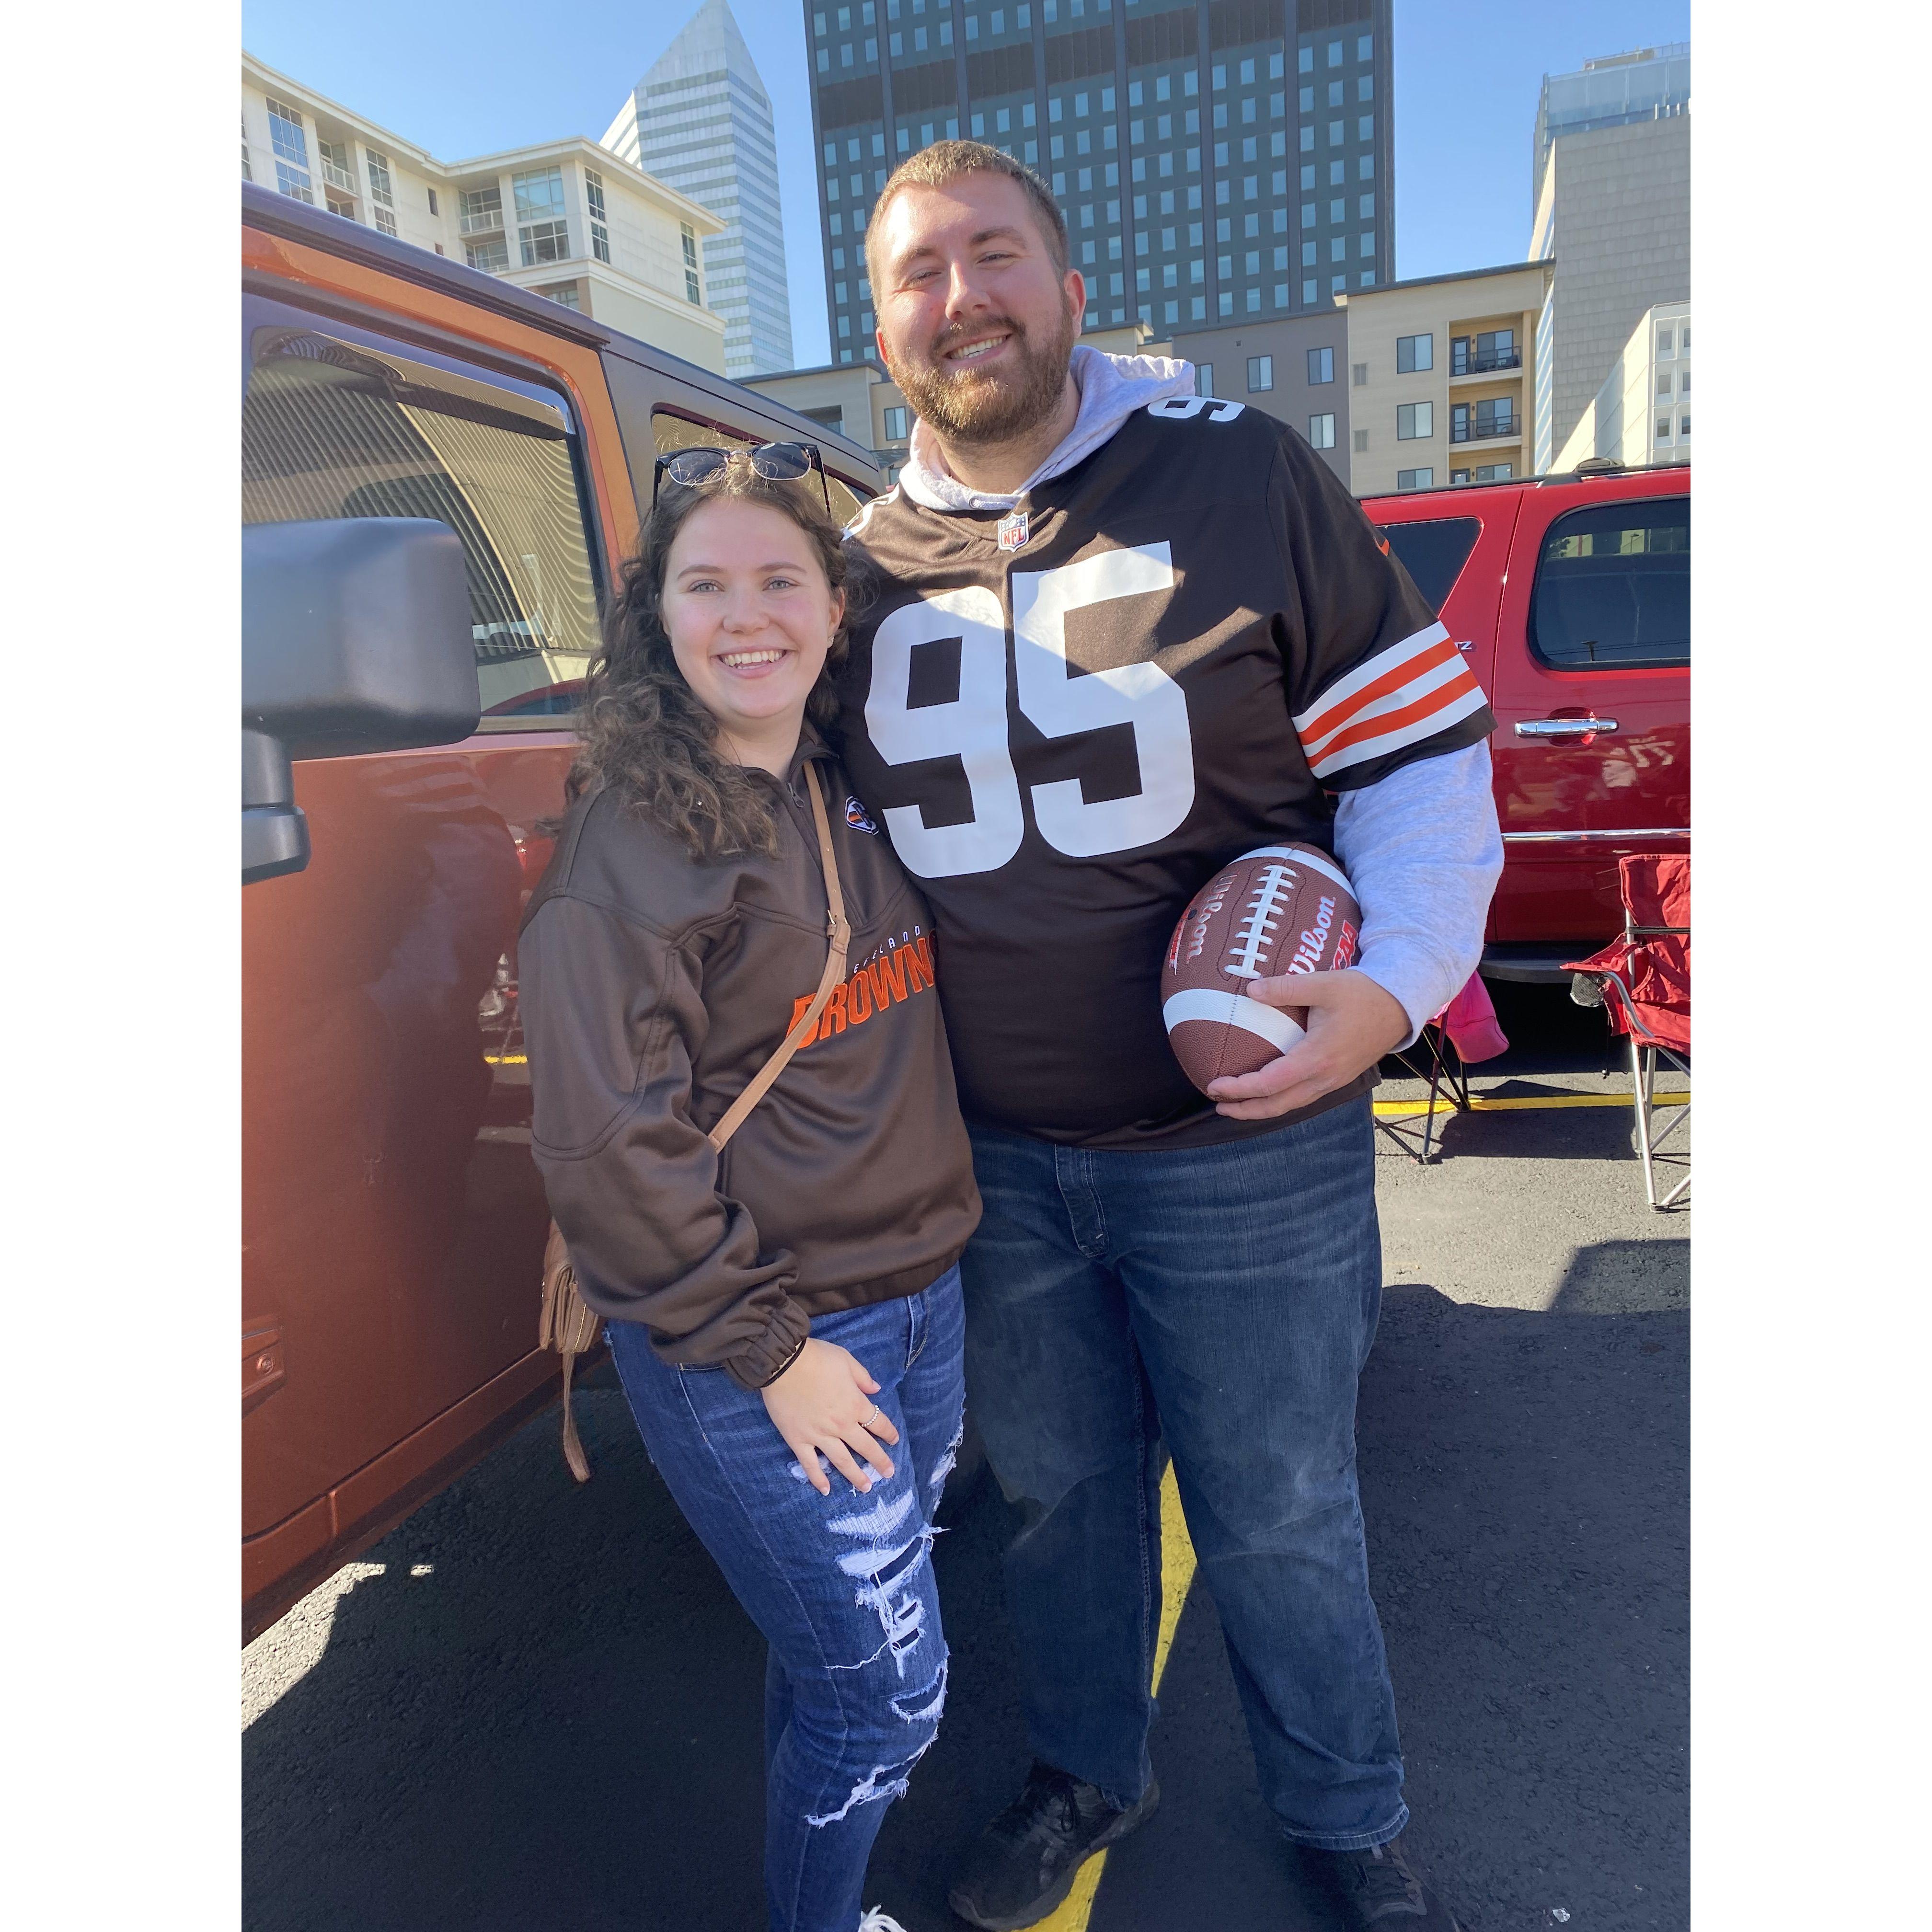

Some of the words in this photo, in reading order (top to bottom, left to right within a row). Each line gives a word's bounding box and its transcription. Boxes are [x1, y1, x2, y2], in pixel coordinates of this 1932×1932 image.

[1003, 528, 1024, 545] NFL
[864, 540, 1196, 879] 95
[1186, 871, 1238, 960] Wilson
[786, 930, 937, 1049] BROWN
